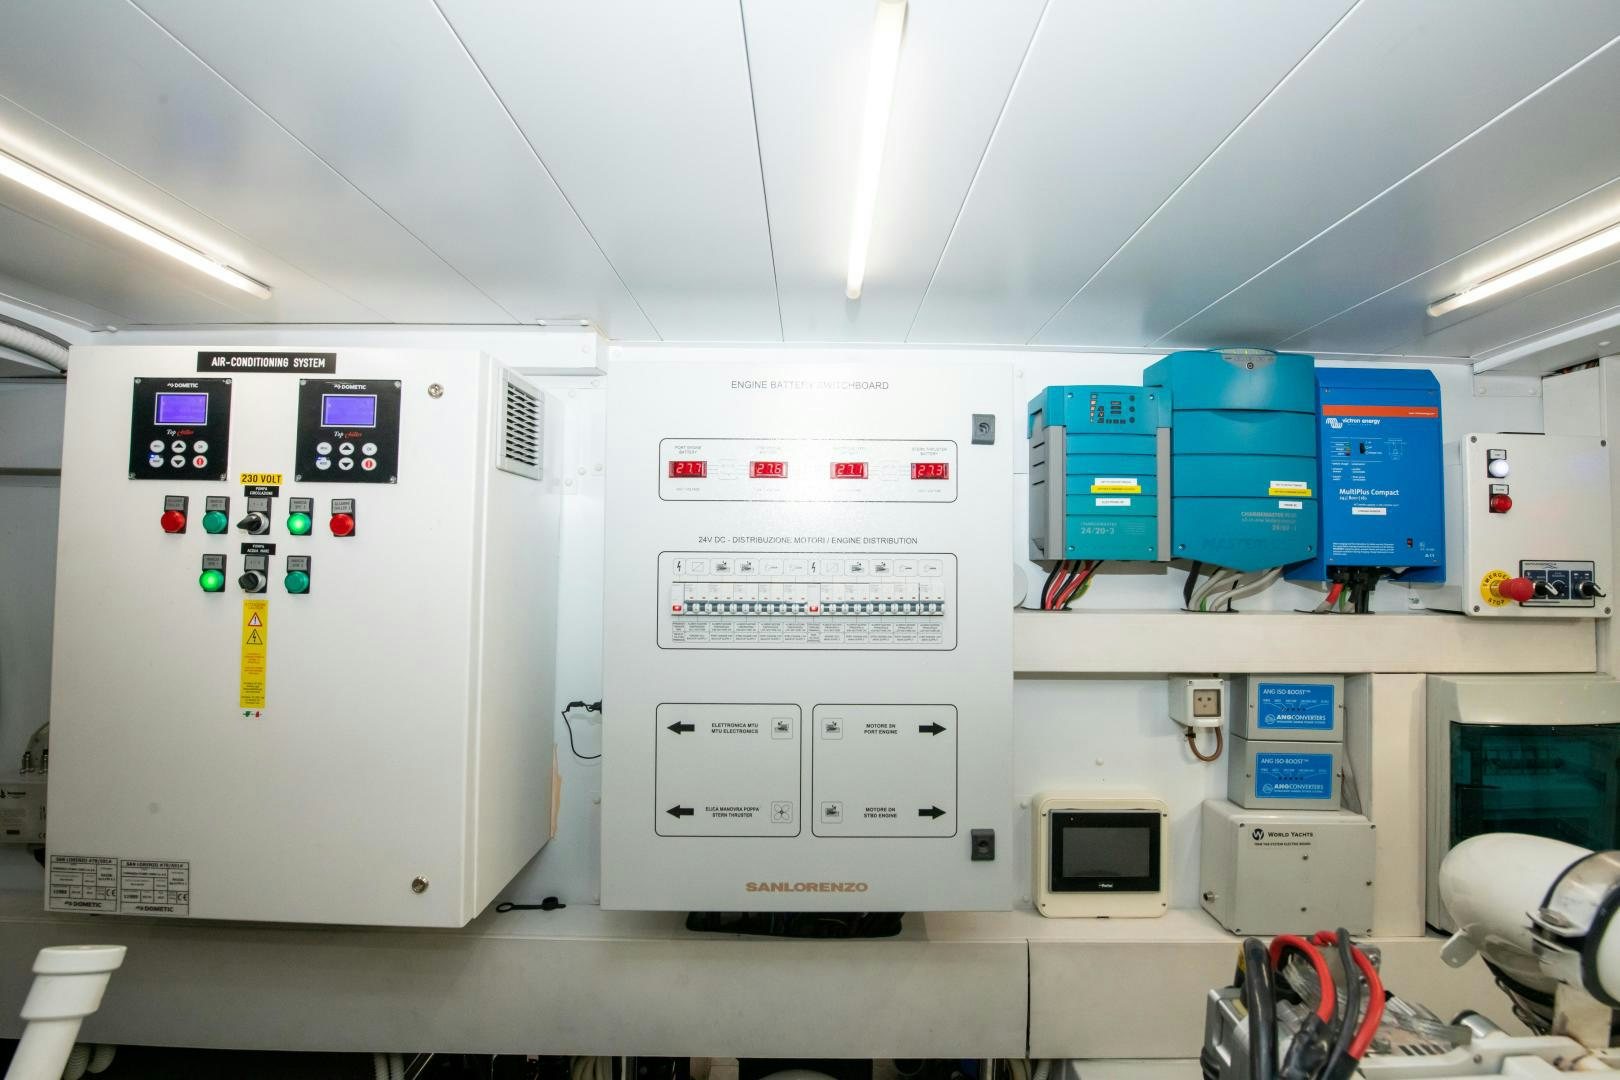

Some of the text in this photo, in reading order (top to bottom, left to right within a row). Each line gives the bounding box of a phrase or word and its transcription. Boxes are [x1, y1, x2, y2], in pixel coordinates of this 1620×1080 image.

[211, 356, 326, 369] AIR-CONDITIONING SYSTEM
[731, 380, 768, 390] ENGINE
[1361, 418, 1381, 426] energy
[167, 428, 177, 437] Top
[334, 430, 345, 440] Top
[242, 474, 282, 483] 230 VOLT
[1338, 488, 1400, 498] MultiPlus Compact
[698, 536, 713, 544] 24V
[714, 536, 726, 544] DC
[732, 536, 792, 544] DISTRIBUZIONE
[831, 537, 861, 545] ENGINE
[862, 537, 918, 545] DISTRIBUTION
[744, 881, 869, 892] SANLORENZO
